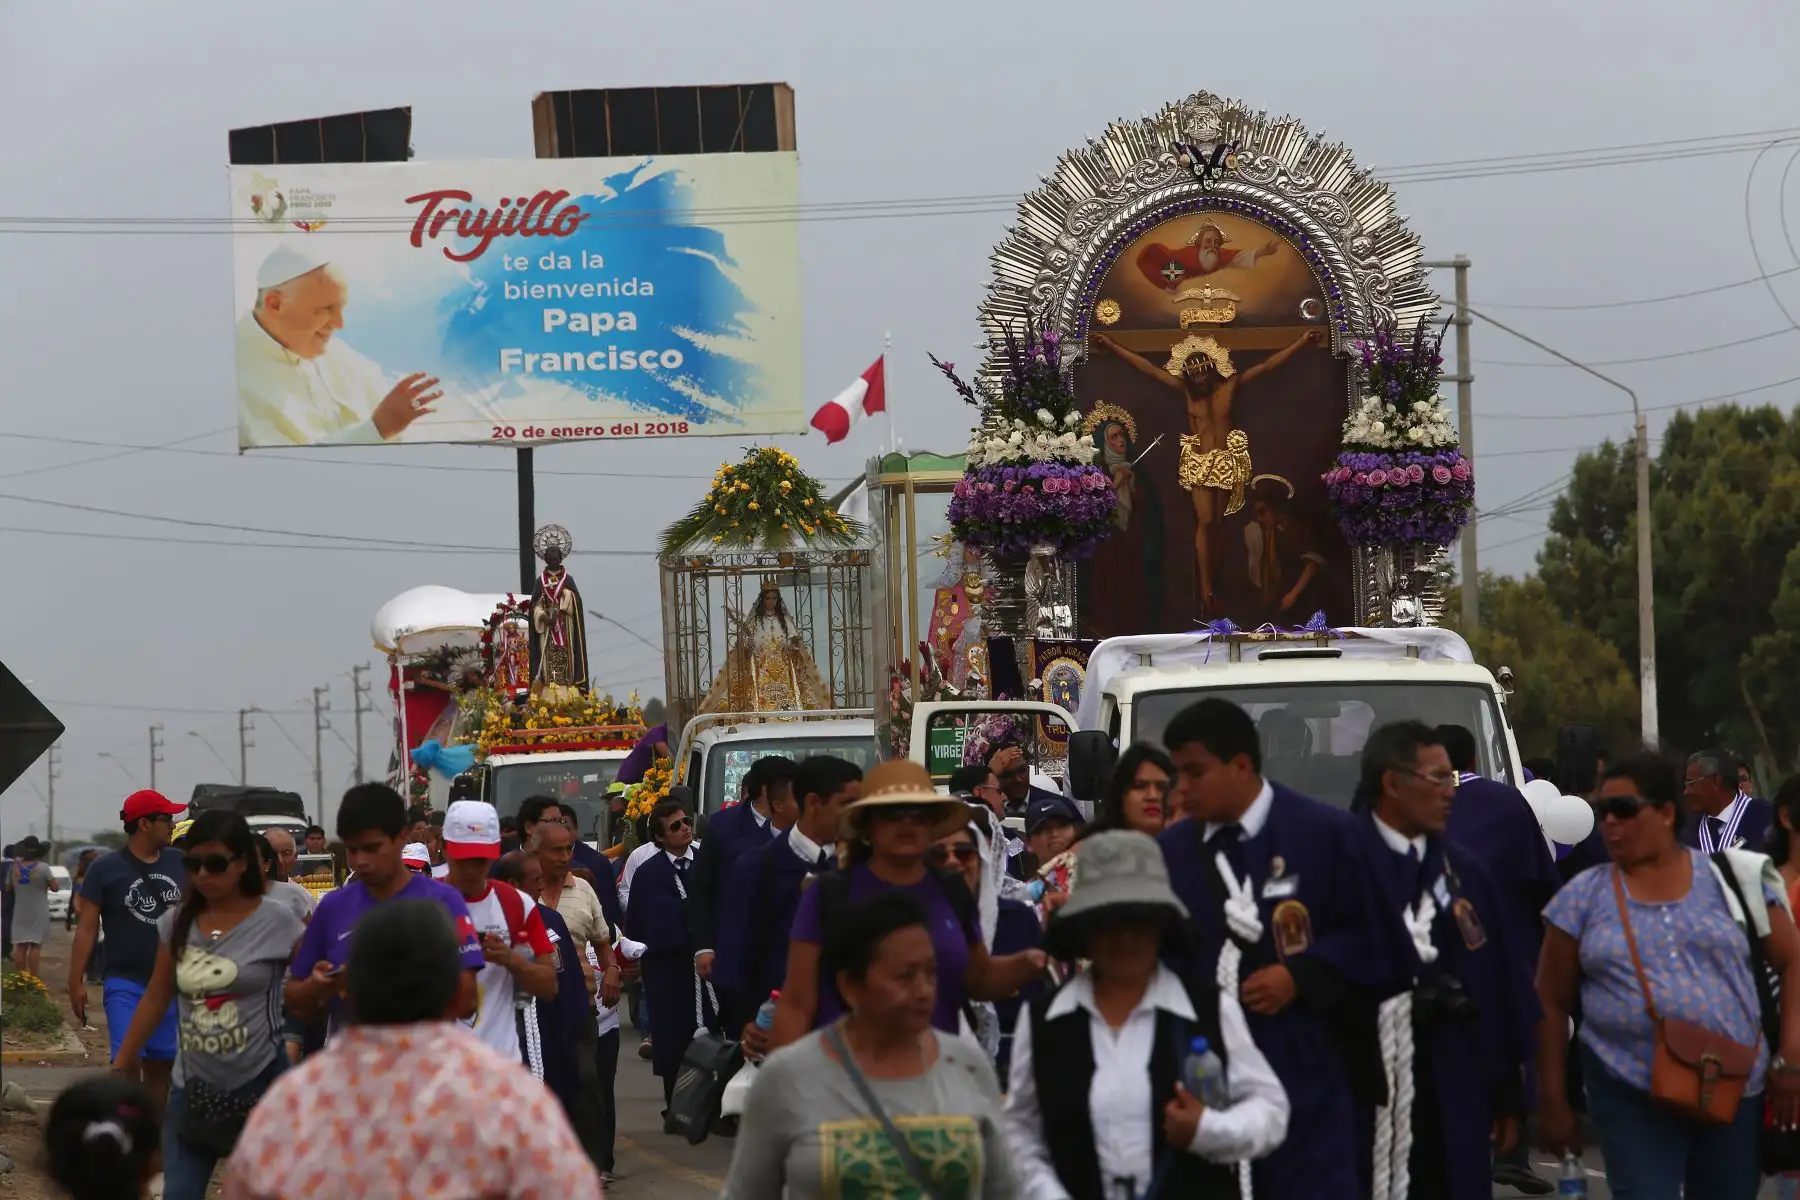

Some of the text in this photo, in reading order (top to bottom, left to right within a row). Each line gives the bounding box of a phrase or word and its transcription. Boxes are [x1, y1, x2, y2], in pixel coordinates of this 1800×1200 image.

[405, 189, 591, 262] Trujillo
[503, 250, 604, 271] te da la
[504, 277, 654, 299] bienvenida
[543, 308, 637, 336] Papa
[500, 345, 684, 373] Francisco
[492, 422, 689, 438] 20 de enero del 2018
[1046, 725, 1070, 735] TRU
